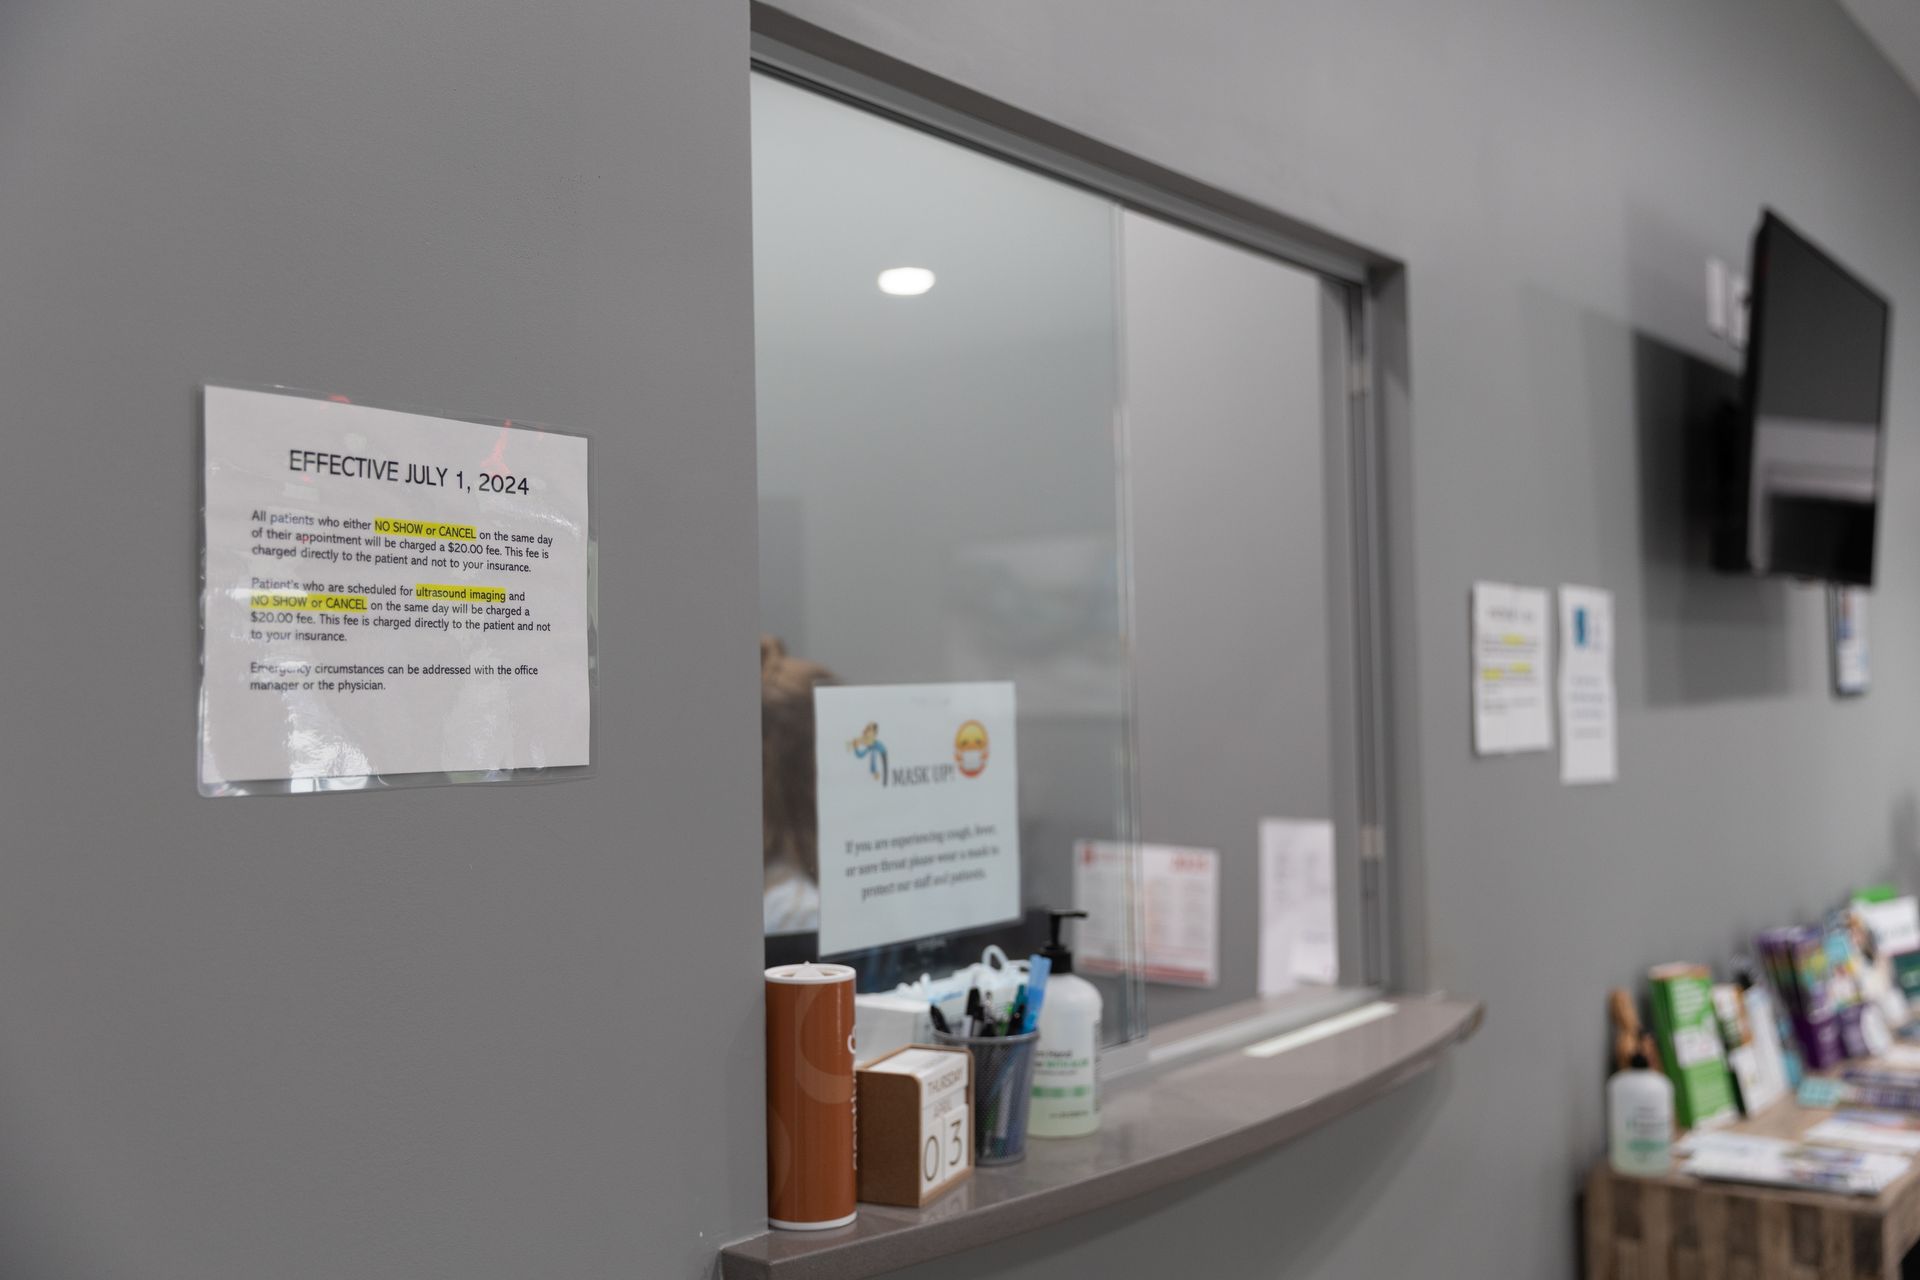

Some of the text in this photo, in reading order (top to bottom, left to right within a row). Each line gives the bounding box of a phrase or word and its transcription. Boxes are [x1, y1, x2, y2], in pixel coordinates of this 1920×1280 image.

[289, 449, 530, 495] EFFECTIVE JULY 1, 2024
[252, 510, 553, 547] All patients who either NO SHOW or CANCEL on the same day
[251, 526, 549, 559] of their appointment will be charged a $20.00 fee. This fee is
[251, 544, 531, 572] charged directly to the patient and not to your insurance.
[303, 580, 325, 591] who
[328, 584, 344, 593] are
[348, 583, 397, 595] scheduled
[400, 585, 413, 596] for
[416, 586, 467, 598] ultrasound
[469, 589, 506, 603] imaging
[509, 592, 525, 601] and
[251, 595, 530, 618] NO SHOW or CANCEL on the same day will be charged a
[251, 611, 551, 632] $20.00 fee. This fee is charged directly to the patient and not
[251, 629, 348, 643] to your insurance.
[315, 664, 384, 674] circumstances
[388, 666, 404, 675] can
[407, 664, 420, 675] be
[422, 664, 471, 675] addressed
[474, 664, 495, 675] with
[497, 664, 512, 675] the
[514, 664, 539, 675] office
[250, 679, 386, 694] manager or the physician.
[892, 766, 930, 786] MASK
[927, 1067, 963, 1093] THURSDAY
